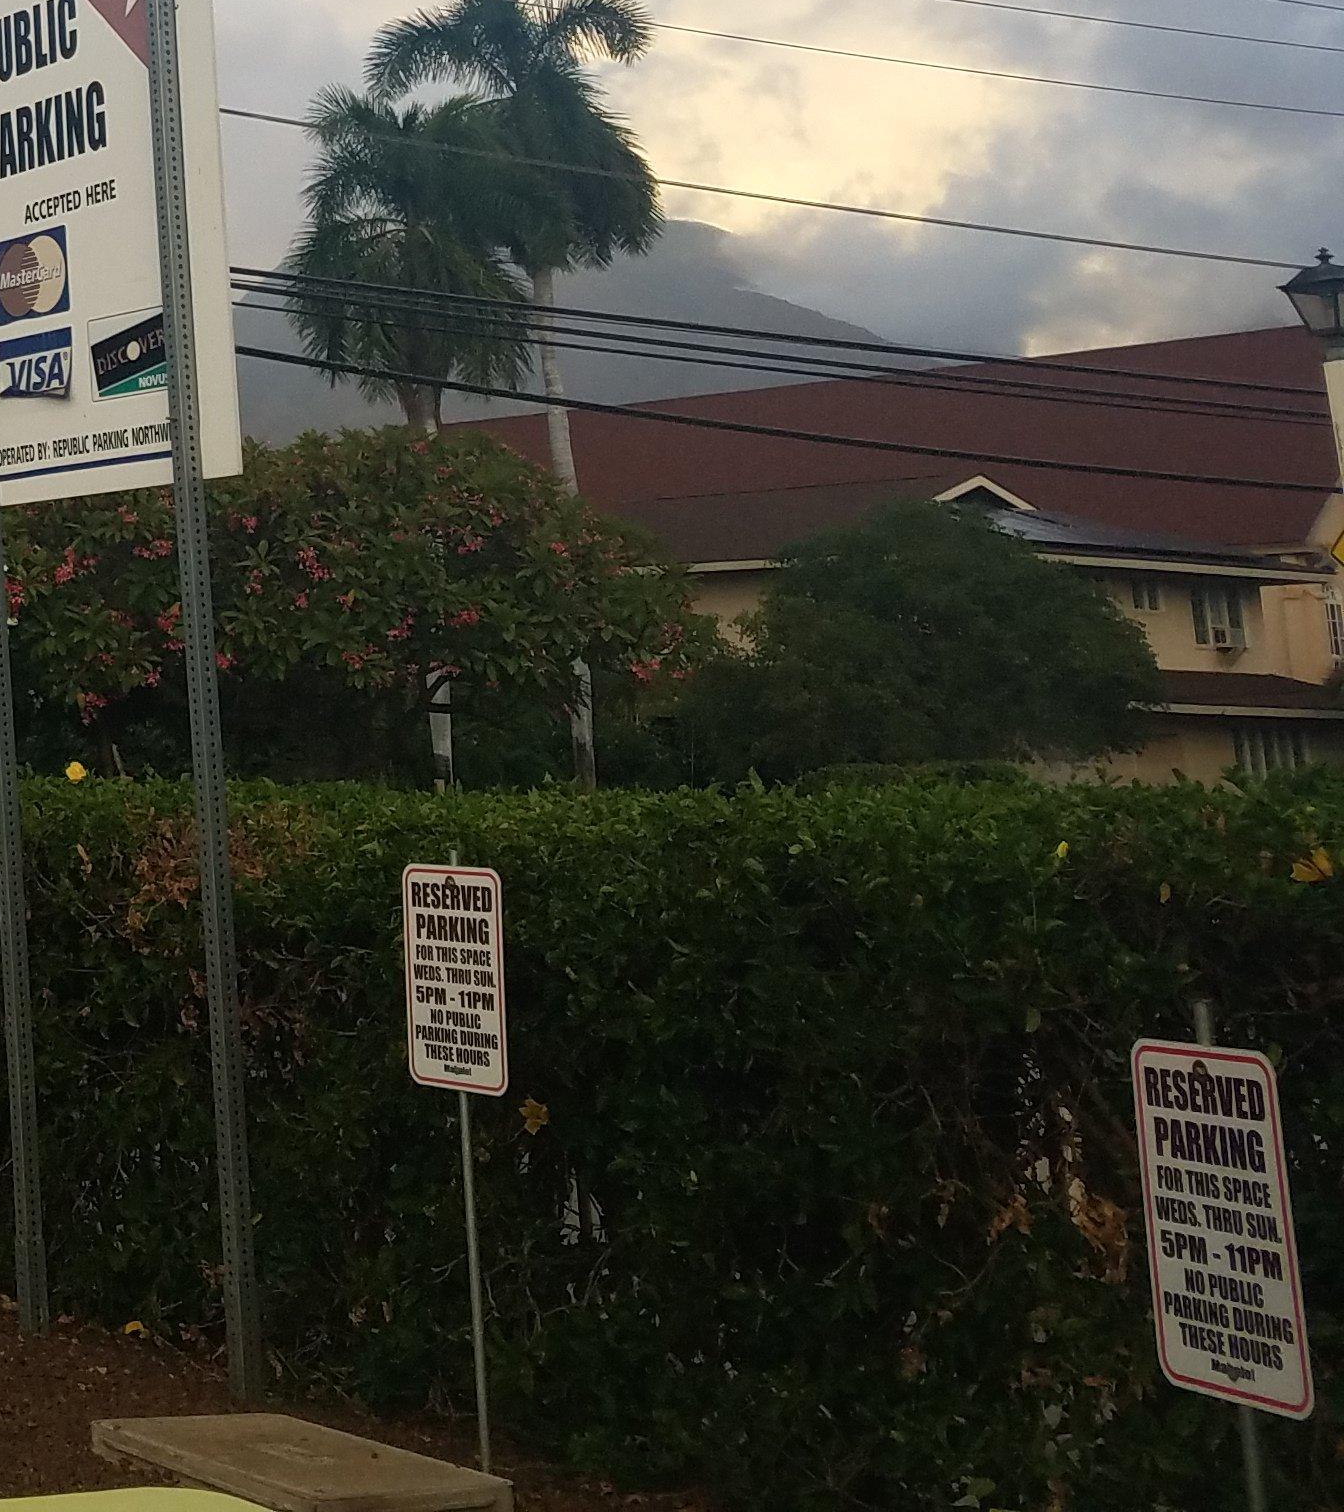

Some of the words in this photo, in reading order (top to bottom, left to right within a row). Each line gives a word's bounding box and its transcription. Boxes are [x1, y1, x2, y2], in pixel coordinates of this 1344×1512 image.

[24, 190, 81, 224] ACCEPTED
[86, 179, 117, 207] HERE
[0, 264, 62, 290] MasterCard
[6, 352, 65, 392] VISA
[53, 435, 90, 459] REPUBLIC
[92, 428, 129, 452] PARKING
[410, 880, 493, 914] RESERVED
[415, 912, 491, 946] PARKING
[415, 944, 434, 962] FOR
[434, 945, 459, 964] THIS
[459, 948, 492, 968] SPACE
[413, 963, 444, 983] WEDS.
[444, 966, 472, 986] THRU
[415, 985, 447, 1006] 5PM
[458, 989, 495, 1012] 11PM
[429, 1008, 444, 1026] NO
[445, 1009, 481, 1030] PUBLIC
[415, 1024, 459, 1045] PARKING
[459, 1029, 499, 1051] DURING
[424, 1042, 455, 1063] THESE
[455, 1046, 491, 1068] HOURS
[1143, 1065, 1265, 1123] RESERVED
[1153, 1116, 1267, 1174] PARKING
[1156, 1164, 1184, 1193] FOR
[1184, 1169, 1221, 1200] THIS
[1221, 1175, 1272, 1209] SPACE
[1201, 1203, 1244, 1237] THRU
[1160, 1228, 1209, 1266] 5PM
[1224, 1242, 1284, 1282] 11PM
[1183, 1267, 1206, 1295] NO
[1207, 1273, 1265, 1309] PUBLIC
[1163, 1290, 1230, 1329] PARKING
[1232, 1306, 1295, 1345] DURING
[1178, 1321, 1227, 1357] THESE
[1227, 1333, 1284, 1371] HOURS
